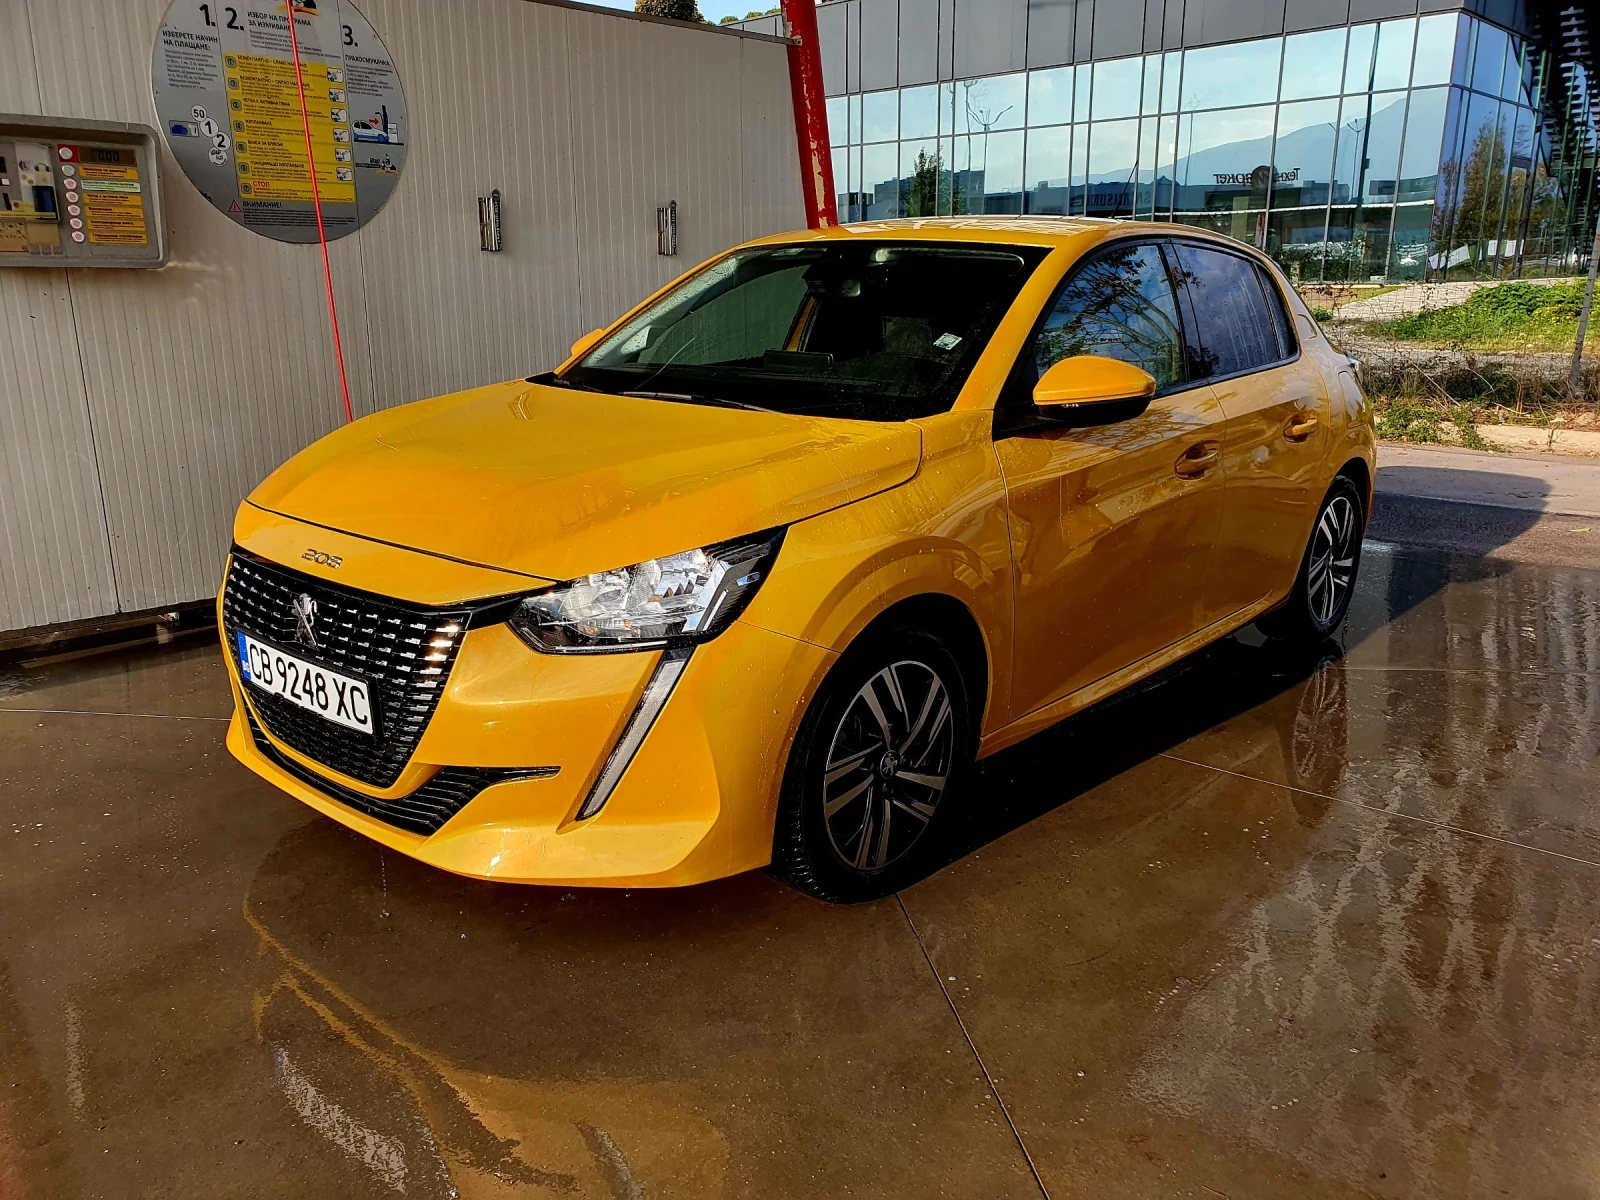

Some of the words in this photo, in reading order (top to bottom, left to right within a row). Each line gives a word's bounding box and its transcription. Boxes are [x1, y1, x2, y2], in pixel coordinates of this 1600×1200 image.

[199, 4, 216, 27] 1.
[225, 7, 245, 31] 2.
[247, 11, 268, 20] ИЗБОР
[279, 16, 312, 26] ПРОРАМА
[162, 30, 194, 40] ИЗБЕРЕТЕ
[195, 35, 218, 43] НАЧИН
[342, 25, 358, 47] 3.
[175, 41, 211, 51] ПЛАЩАНЕ:
[193, 109, 205, 119] 50
[204, 121, 212, 135] 1
[216, 134, 226, 148] 2
[242, 201, 282, 209] ВНИМАНИЕ!
[301, 548, 343, 569] 208
[249, 643, 273, 686] CB
[275, 656, 329, 711] 9248
[332, 677, 368, 726] XC
